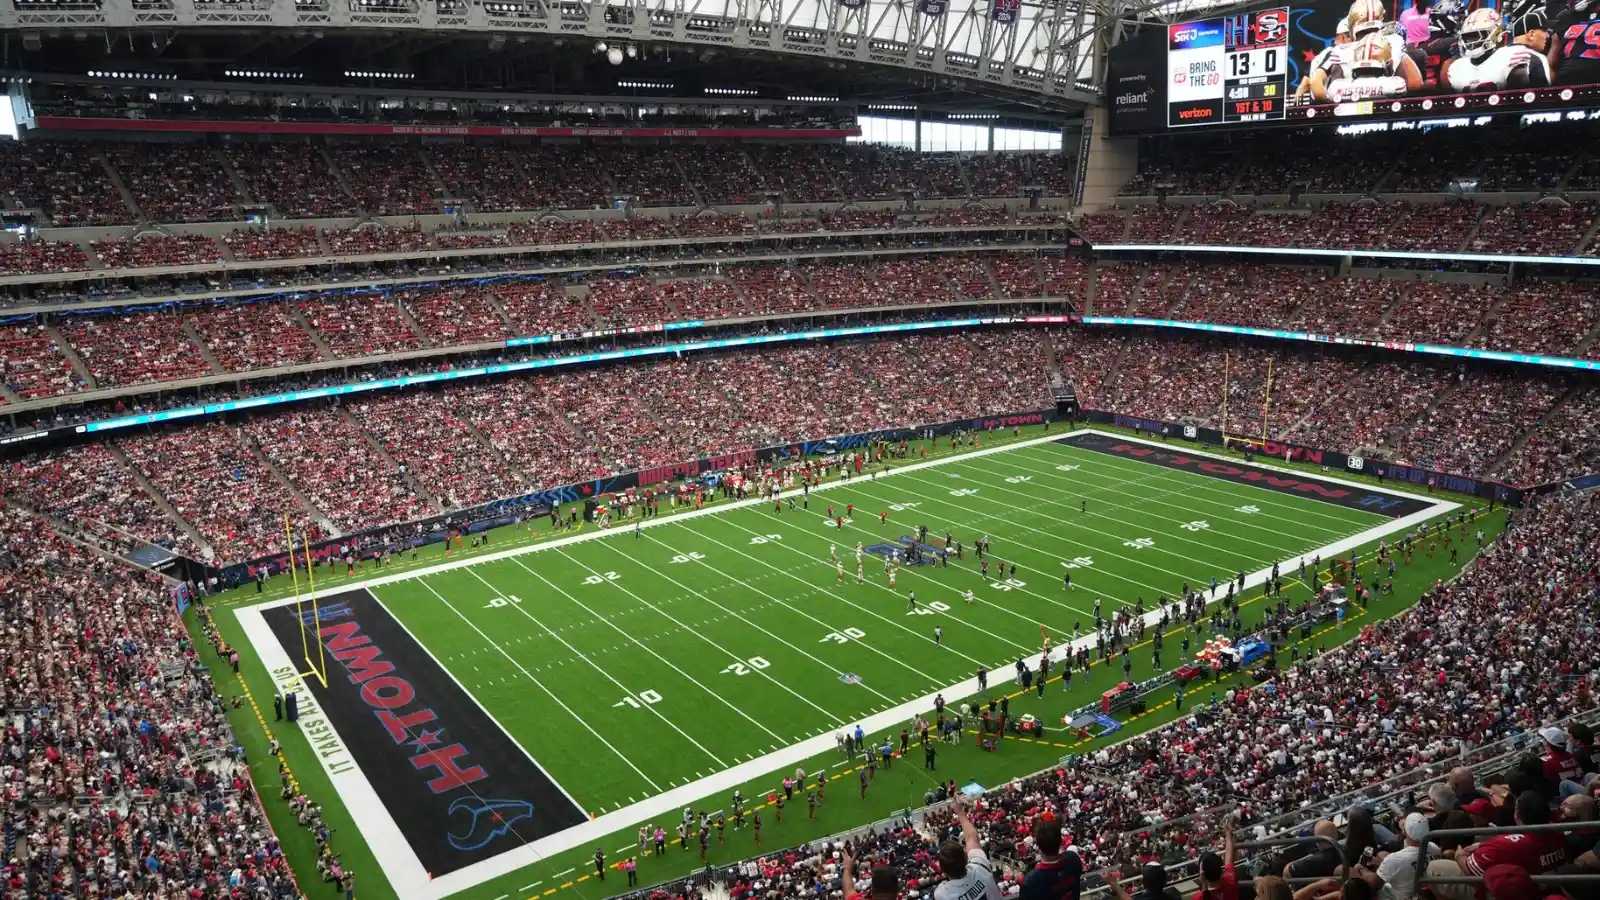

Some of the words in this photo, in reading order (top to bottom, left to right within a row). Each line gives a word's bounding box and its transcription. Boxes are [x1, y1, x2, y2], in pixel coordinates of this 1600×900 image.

[1189, 61, 1217, 74] BRING
[1229, 52, 1250, 76] 13
[1265, 49, 1277, 73] 0
[1189, 74, 1206, 87] THE
[1206, 72, 1220, 86] GO
[1116, 92, 1148, 105] reliant
[1263, 84, 1276, 97] 30
[1179, 107, 1212, 119] verizon
[1235, 102, 1251, 113] 1ST
[1261, 100, 1273, 111] 10
[984, 415, 1043, 427] H-TOWN
[1349, 457, 1362, 469] 30
[989, 578, 1027, 592] 50
[914, 601, 951, 616] 40
[826, 627, 866, 645] 30
[272, 665, 294, 682] US
[727, 656, 771, 676] 20
[622, 689, 663, 709] 10
[296, 695, 320, 721] ALL
[304, 719, 344, 759] TAKES
[328, 758, 355, 776] IT
[1540, 848, 1566, 867] KITTL
